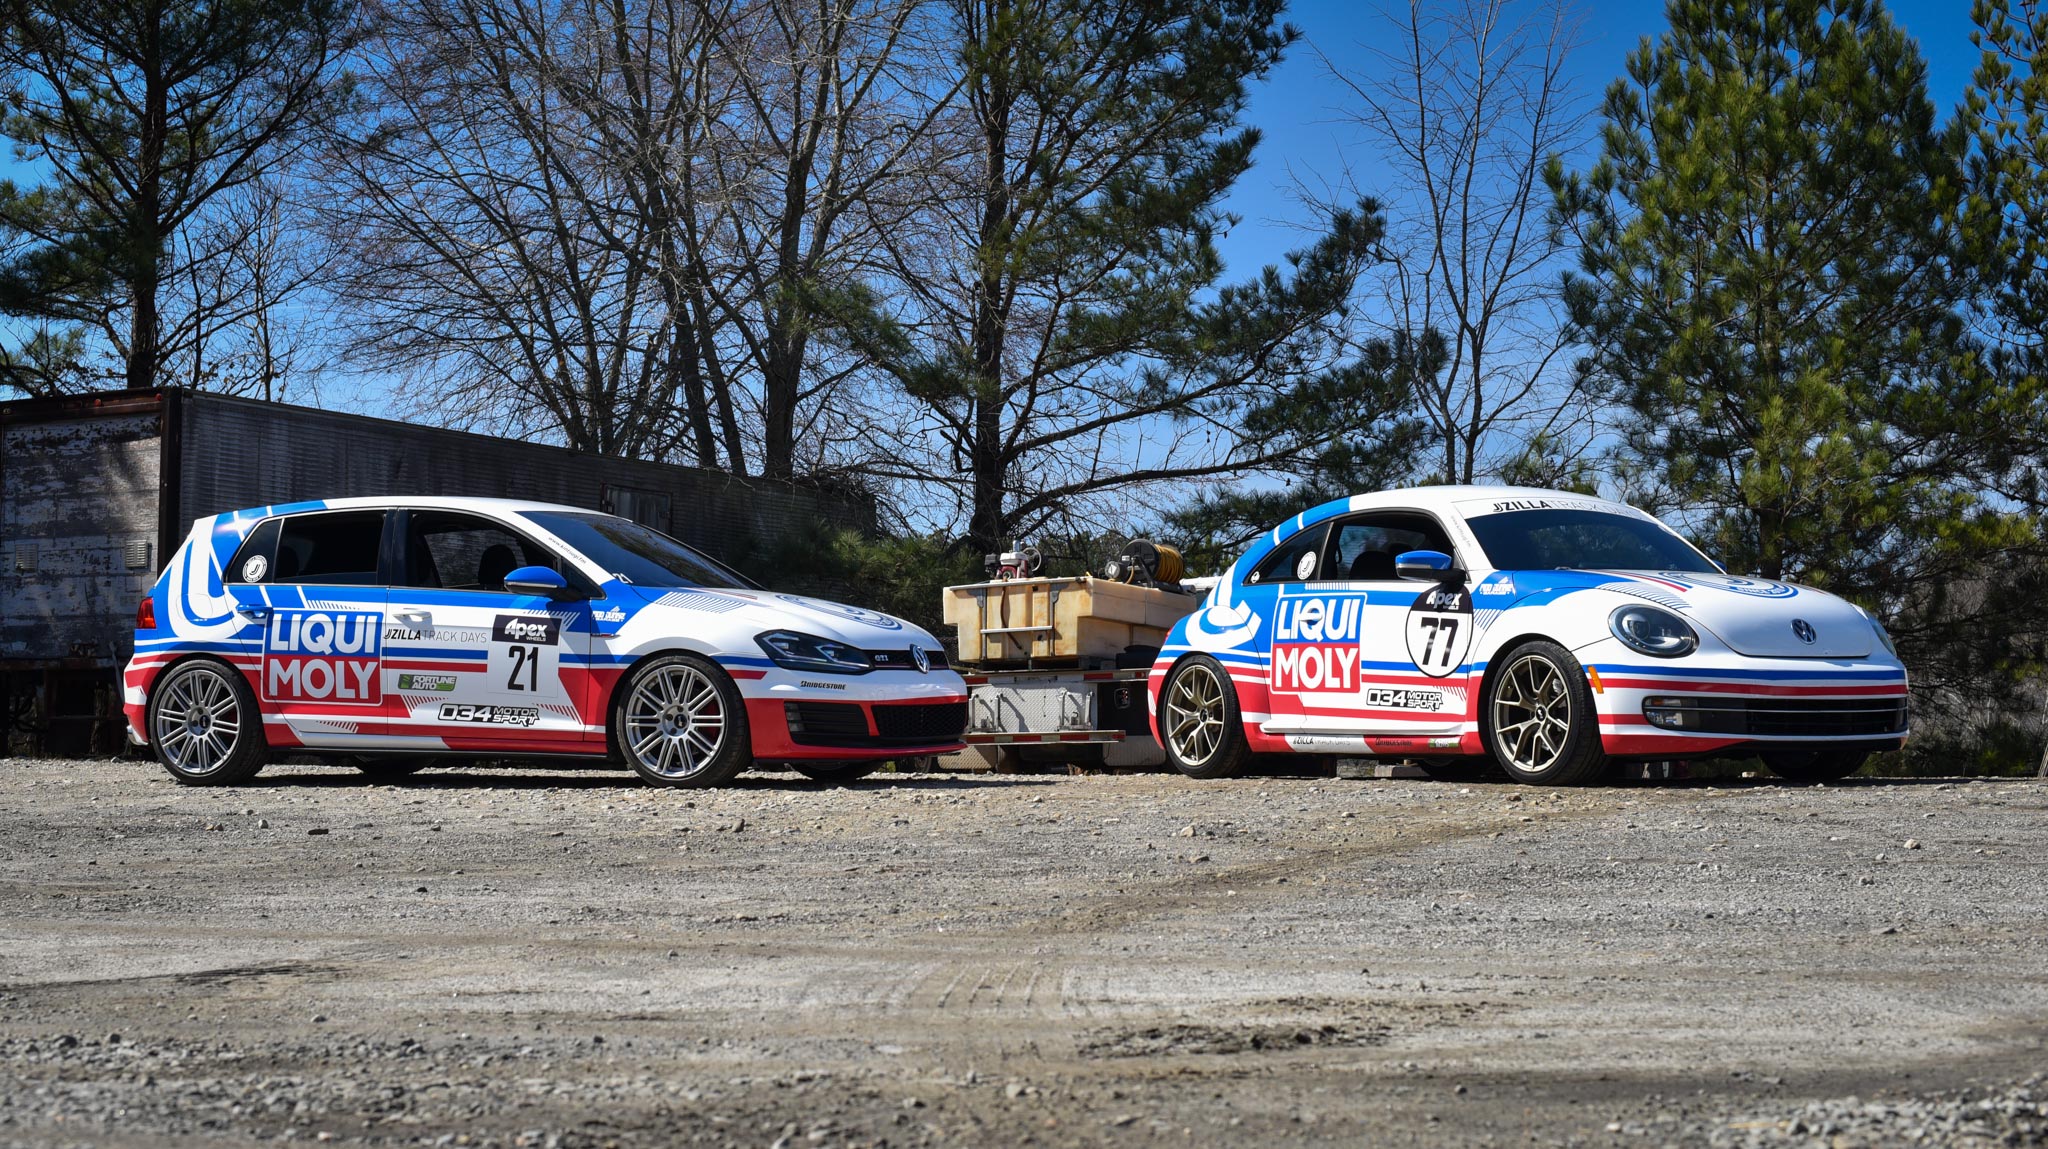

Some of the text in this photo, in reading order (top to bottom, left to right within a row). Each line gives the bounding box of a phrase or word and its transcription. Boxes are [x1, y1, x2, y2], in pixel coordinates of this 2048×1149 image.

[612, 572, 634, 584] 21
[504, 617, 548, 640] Apex
[1276, 598, 1361, 643] LIQUI
[270, 613, 378, 655] LIQUI
[422, 629, 457, 642] TRACK
[460, 631, 488, 643] DAYS
[1420, 616, 1459, 667] 77
[874, 654, 889, 662] GTI
[507, 645, 539, 692] 21
[1275, 646, 1359, 689] MOLY
[268, 658, 379, 699] MOLY
[411, 682, 437, 690] AUTO
[413, 675, 457, 685] FORTUNE
[1366, 688, 1407, 707] 034
[1406, 691, 1442, 702] MOTOR
[439, 704, 492, 722] 034
[493, 706, 538, 716] MOTOR
[1406, 699, 1442, 711] SPORT
[493, 714, 539, 727] SPORT
